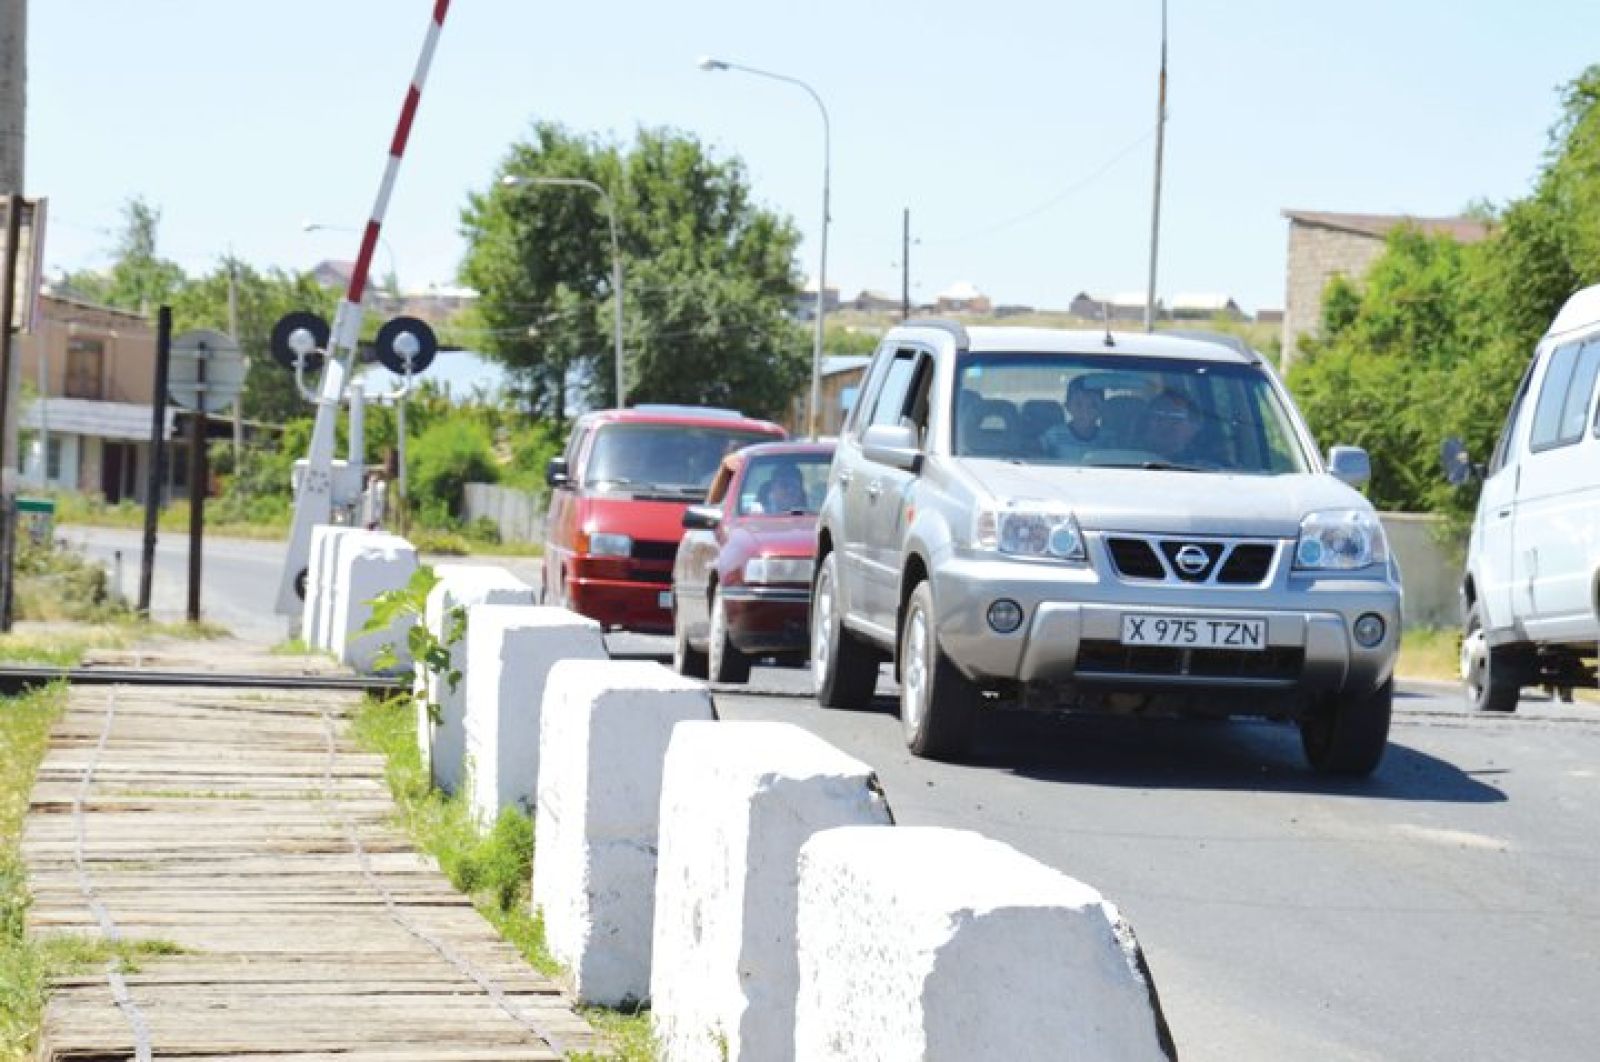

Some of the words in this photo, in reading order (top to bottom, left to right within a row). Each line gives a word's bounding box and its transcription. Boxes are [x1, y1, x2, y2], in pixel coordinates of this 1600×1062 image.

[1129, 617, 1146, 641] X
[1155, 619, 1198, 643] 975
[1206, 621, 1259, 645] TZN
